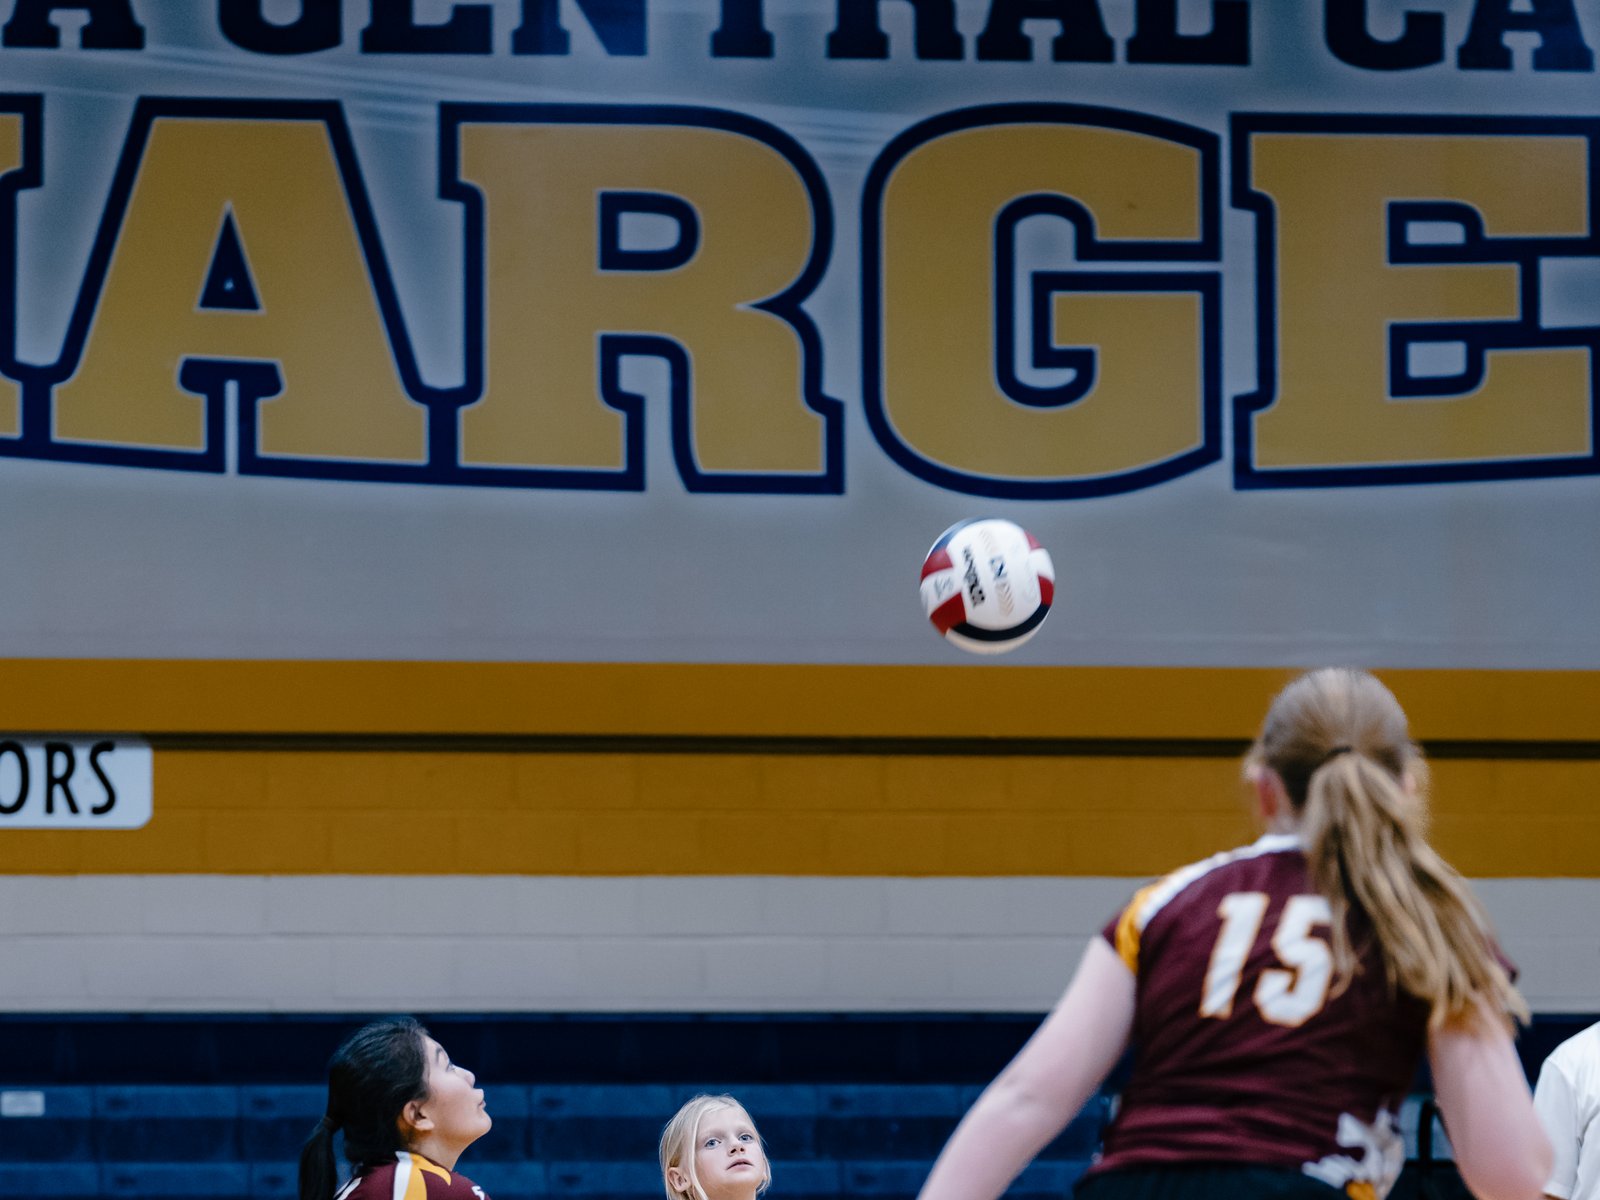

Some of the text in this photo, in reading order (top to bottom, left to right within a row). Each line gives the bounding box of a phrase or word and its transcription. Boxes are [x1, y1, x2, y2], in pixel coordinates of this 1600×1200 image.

[0, 92, 1600, 500] ARGE
[0, 741, 117, 815] ORS
[1199, 892, 1333, 1028] 15
